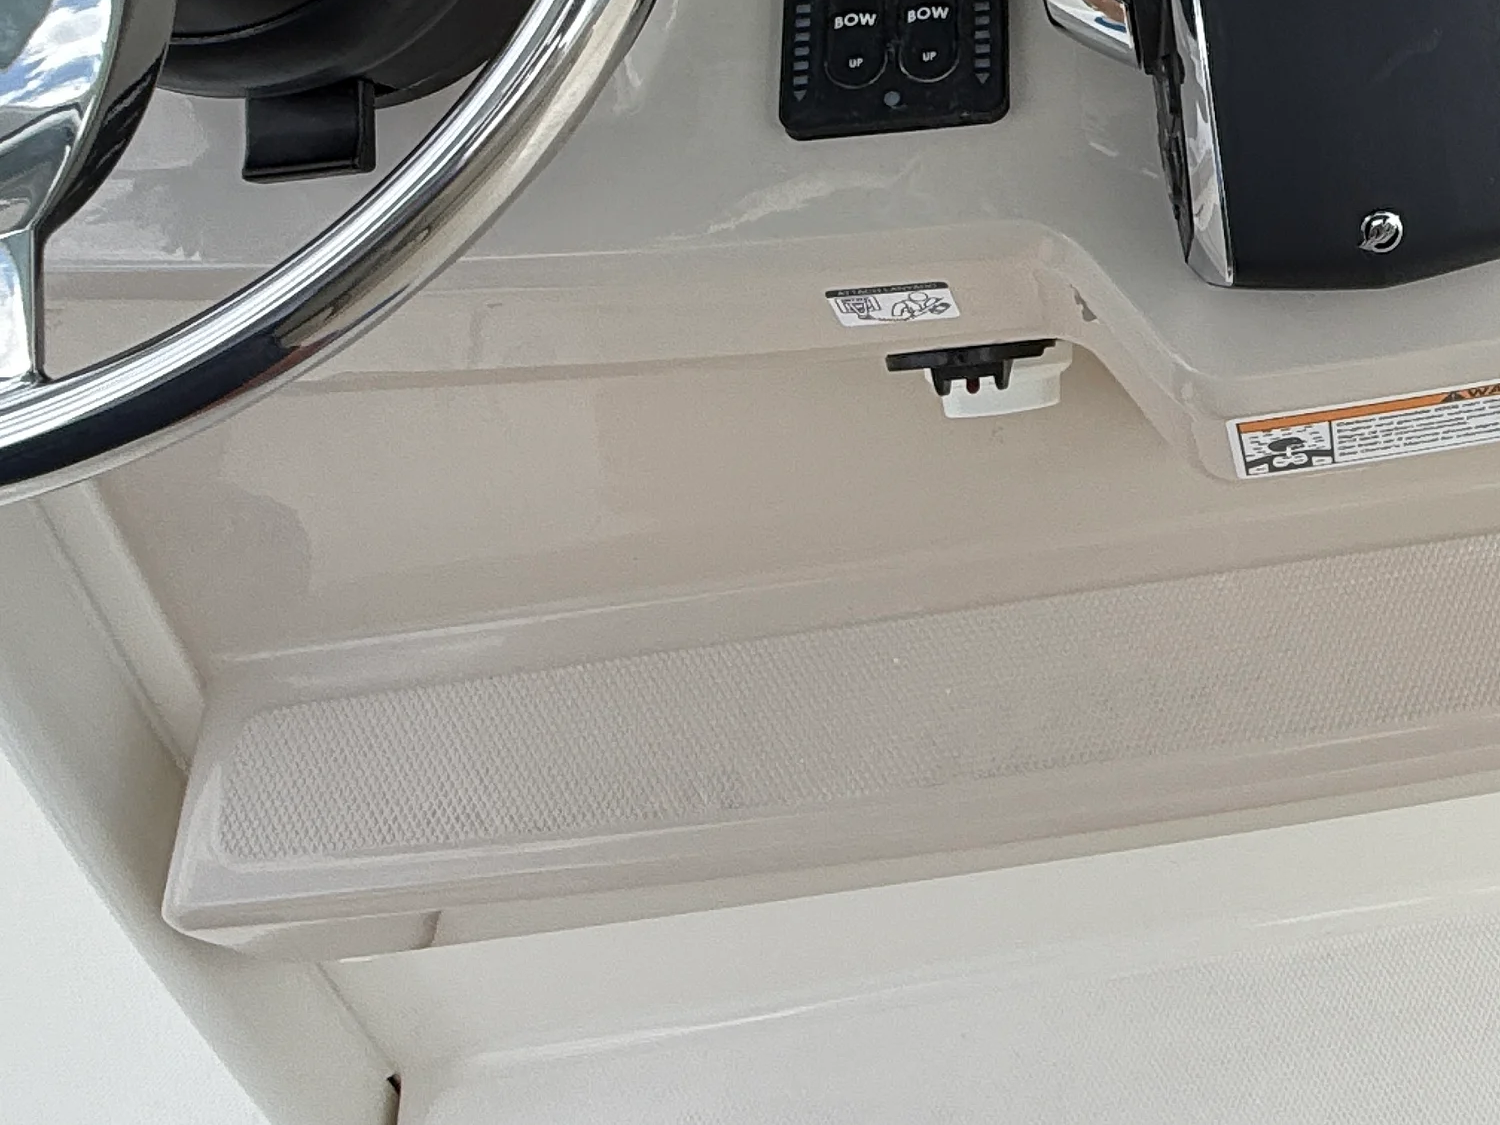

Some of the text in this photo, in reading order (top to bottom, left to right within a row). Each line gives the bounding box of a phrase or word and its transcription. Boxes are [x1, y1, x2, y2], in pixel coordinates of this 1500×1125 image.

[833, 13, 877, 30] BOW
[907, 6, 949, 23] BOW
[848, 58, 864, 69] UP
[922, 51, 937, 62] UP
